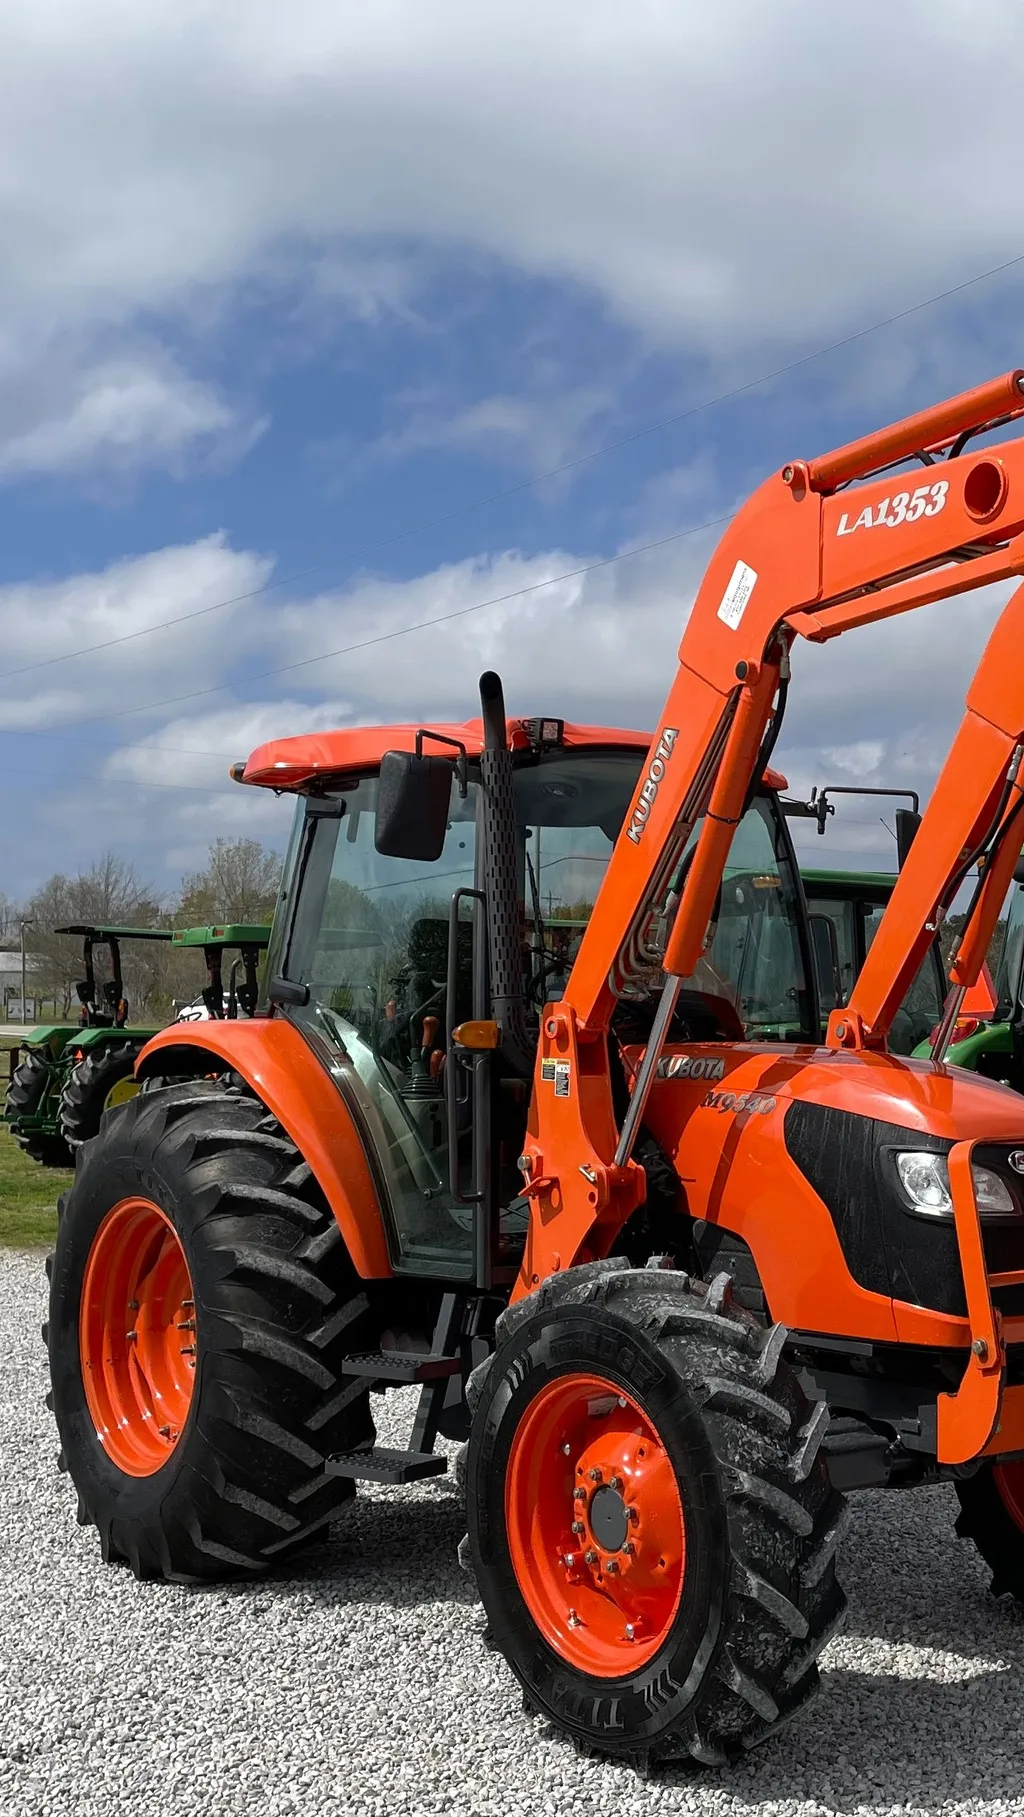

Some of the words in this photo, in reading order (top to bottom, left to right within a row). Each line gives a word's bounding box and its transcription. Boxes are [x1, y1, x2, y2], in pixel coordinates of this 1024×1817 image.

[836, 480, 950, 536] LA1353
[626, 727, 679, 845] KUBOTA
[656, 1055, 725, 1079] KUBOTA
[700, 1091, 777, 1115] M9540
